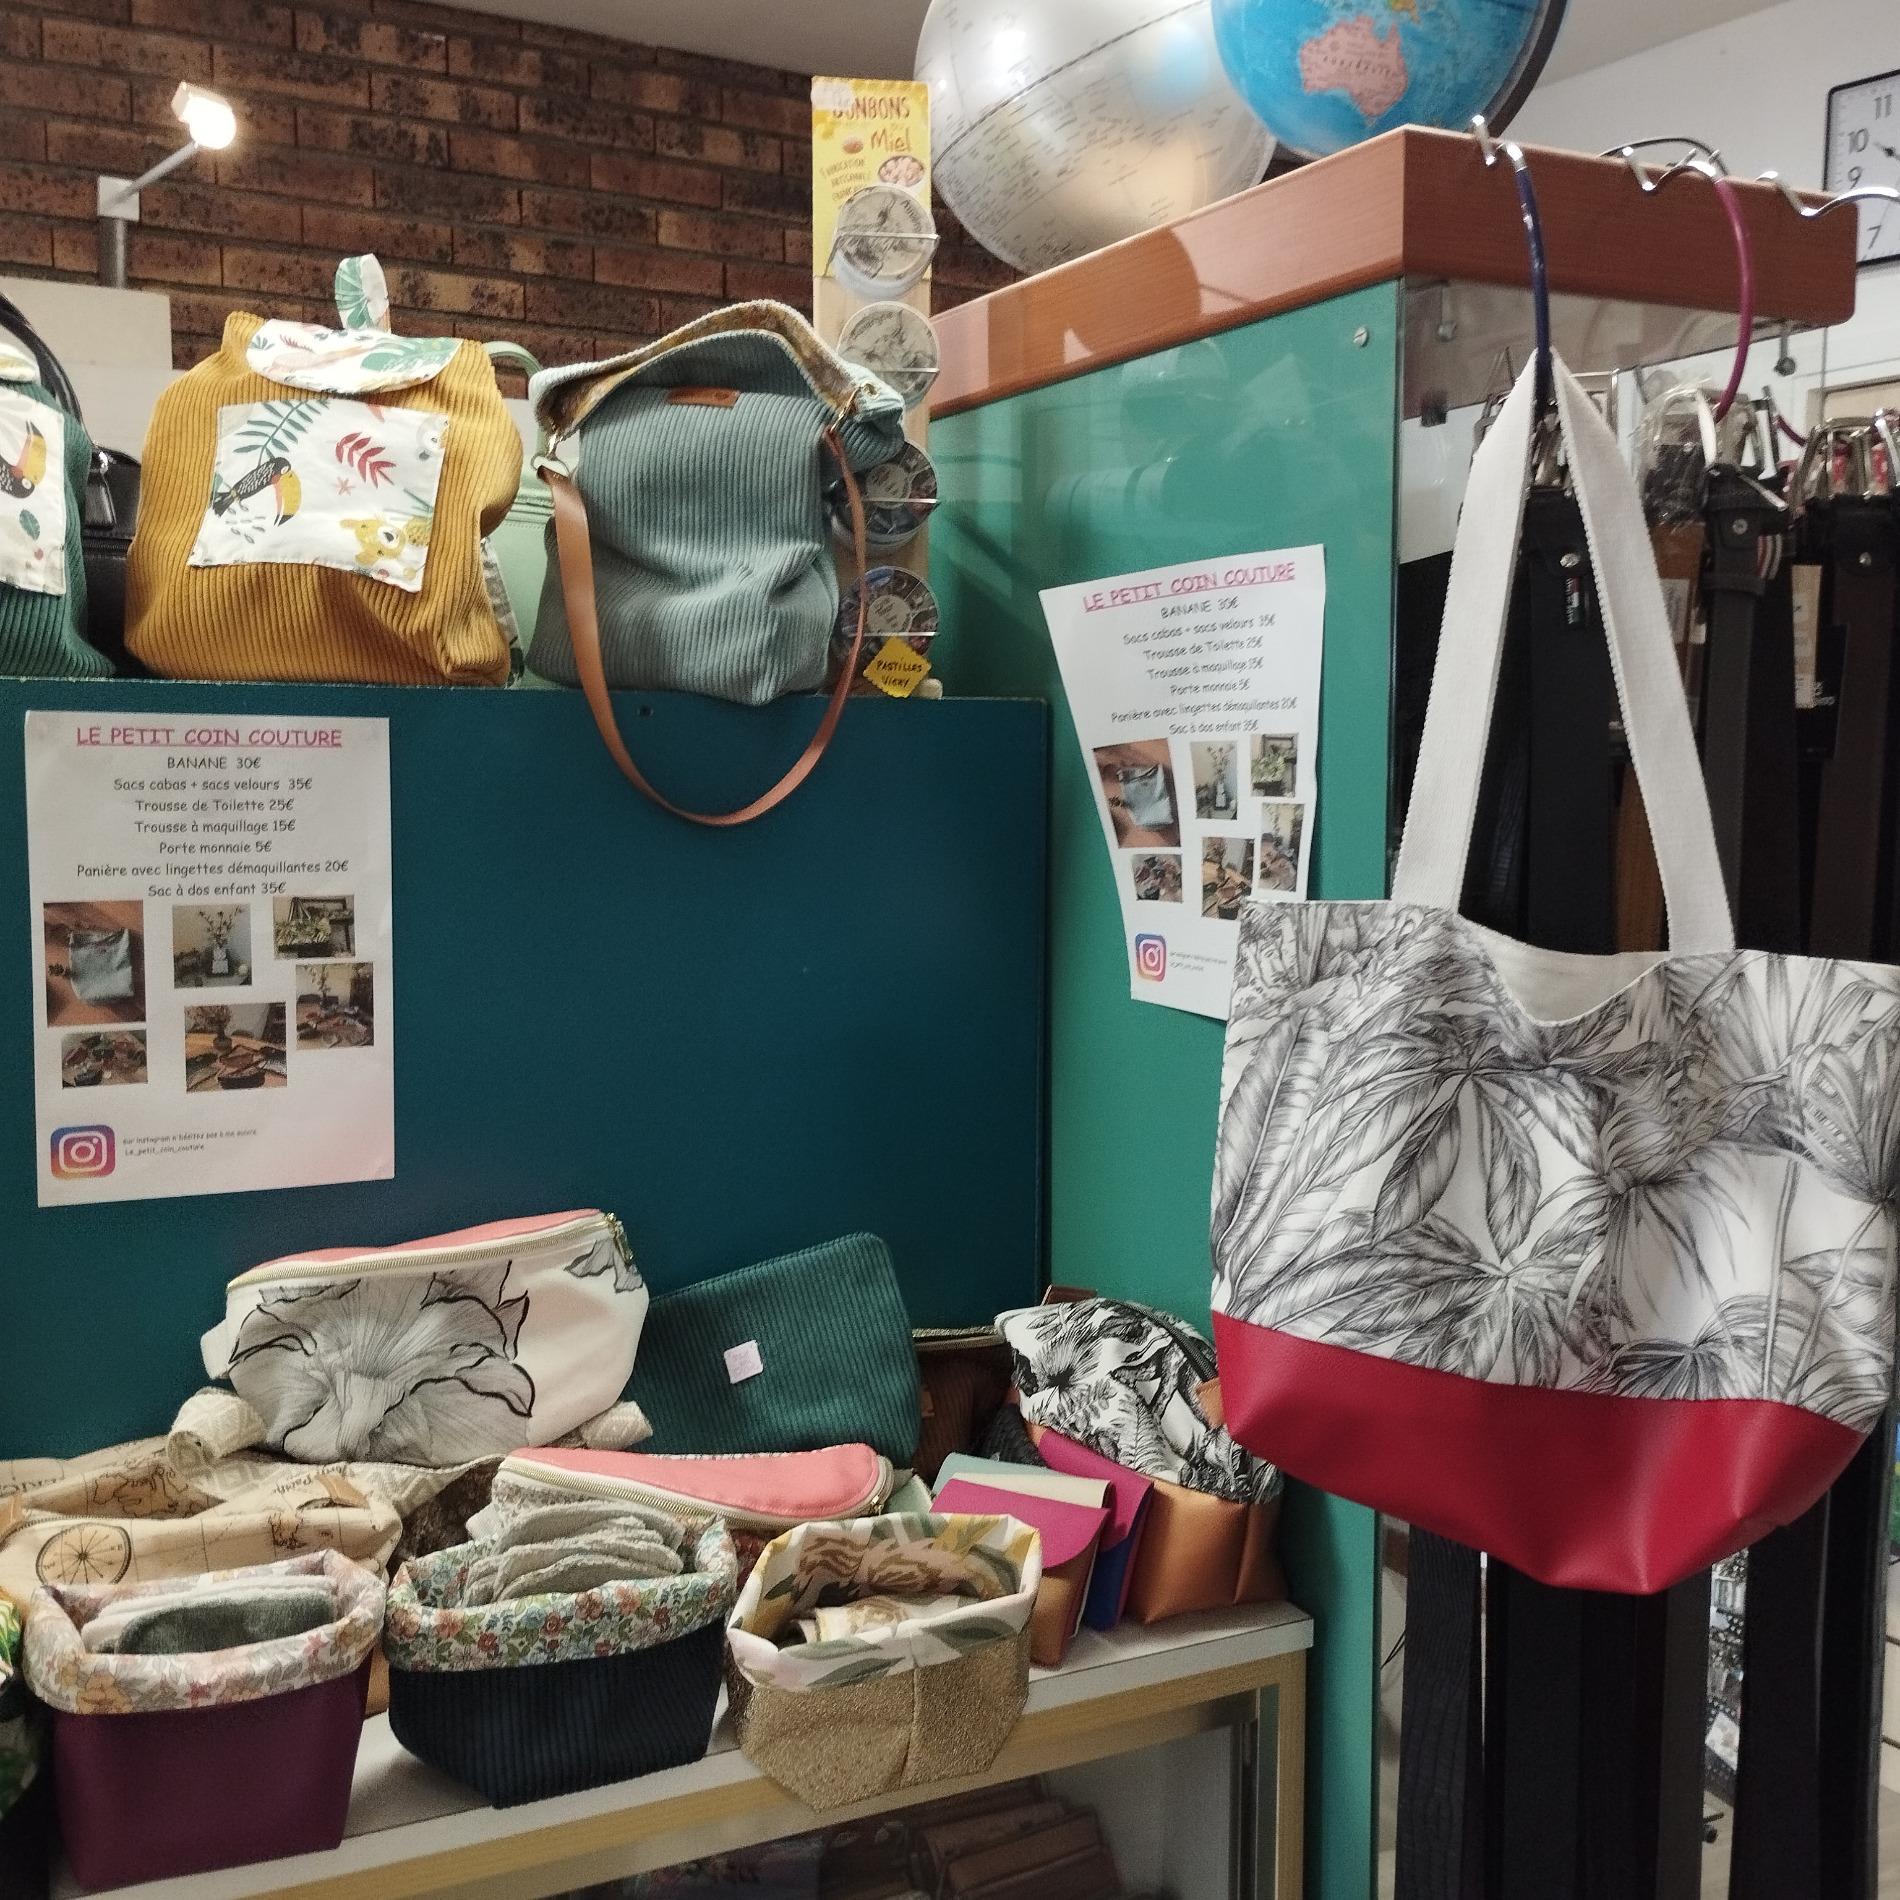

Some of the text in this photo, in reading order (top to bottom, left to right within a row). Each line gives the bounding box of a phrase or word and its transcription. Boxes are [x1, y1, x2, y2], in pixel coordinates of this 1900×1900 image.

[1874, 94, 1893, 120] 11
[870, 127, 911, 152] Miel
[1847, 127, 1870, 154] 10
[1847, 165, 1863, 189] 9
[1867, 224, 1882, 250] 7
[1082, 562, 1296, 612] LE PETIT COIN COUTURE
[1160, 596, 1240, 619] BANANE 30€
[1122, 631, 1149, 645] Sacs
[1219, 618, 1254, 631] velours
[1143, 648, 1187, 662] Trousse
[1190, 644, 1203, 655] de
[1204, 639, 1246, 652] Toilette
[1146, 667, 1190, 681] Trousse
[1170, 683, 1200, 696] Porte
[1111, 709, 1152, 723] Panière
[1153, 706, 1177, 718] avec
[1179, 701, 1222, 718] lingettes
[76, 726, 343, 747] LE PETIT COIN COUTURE
[1169, 722, 1188, 734] Sac
[1216, 719, 1242, 733] enfant
[167, 757, 261, 770] BANANE 30€
[113, 778, 145, 791] Sacs
[149, 777, 187, 791] cabas
[201, 780, 230, 790] sacs
[234, 778, 280, 790] velours
[288, 778, 312, 790] 35€
[135, 798, 294, 812] Trousse de Toilette 25€
[135, 820, 296, 835] Trousse à maquillage 15€
[159, 840, 273, 854] Porte monnaie 5€
[77, 860, 348, 877] Panière avec lingettes démaquillantes 20€
[148, 882, 287, 896] Sac à dos enfant 35€
